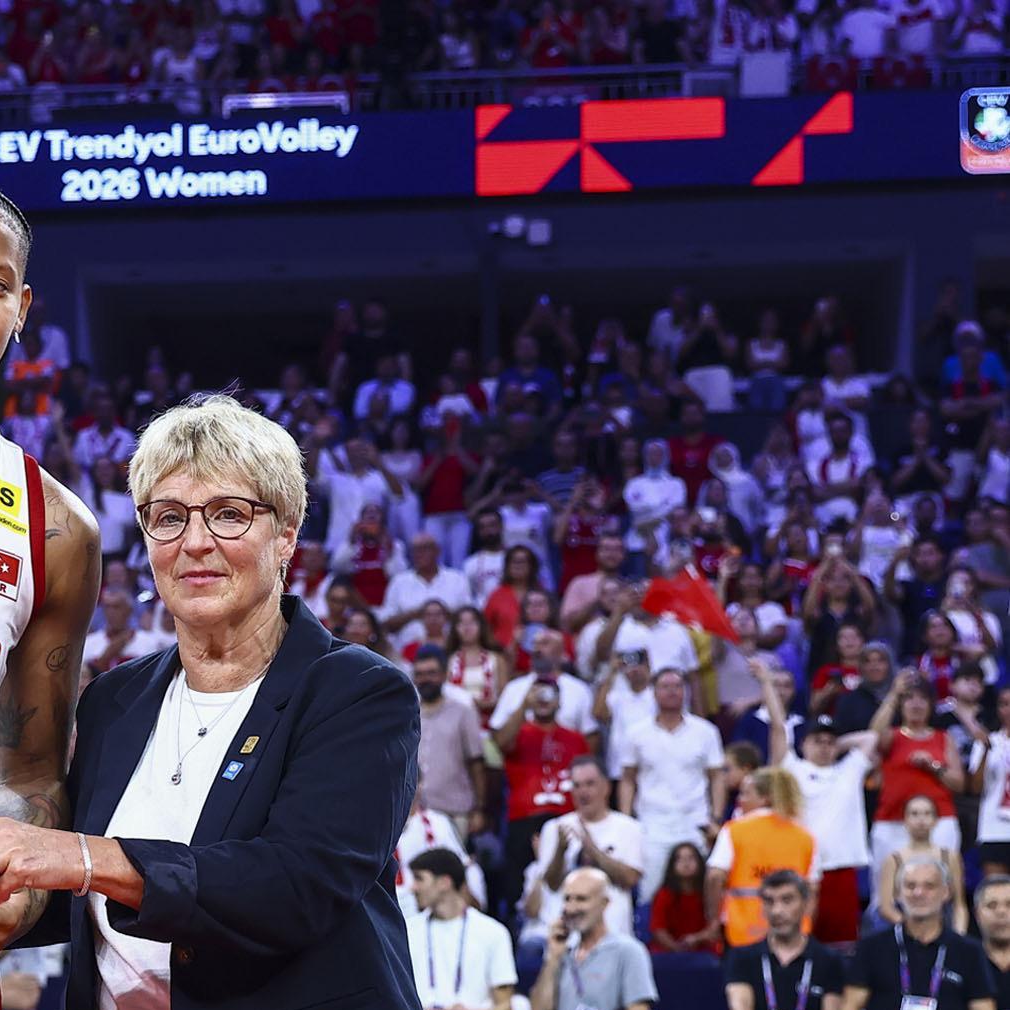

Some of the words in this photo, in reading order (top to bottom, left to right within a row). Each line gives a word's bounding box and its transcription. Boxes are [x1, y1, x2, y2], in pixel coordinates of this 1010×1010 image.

[44, 123, 184, 165] Trendyol
[188, 118, 359, 158] EuroVolley
[61, 168, 140, 201] 2026
[143, 166, 267, 199] Women
[0, 487, 15, 507] S
